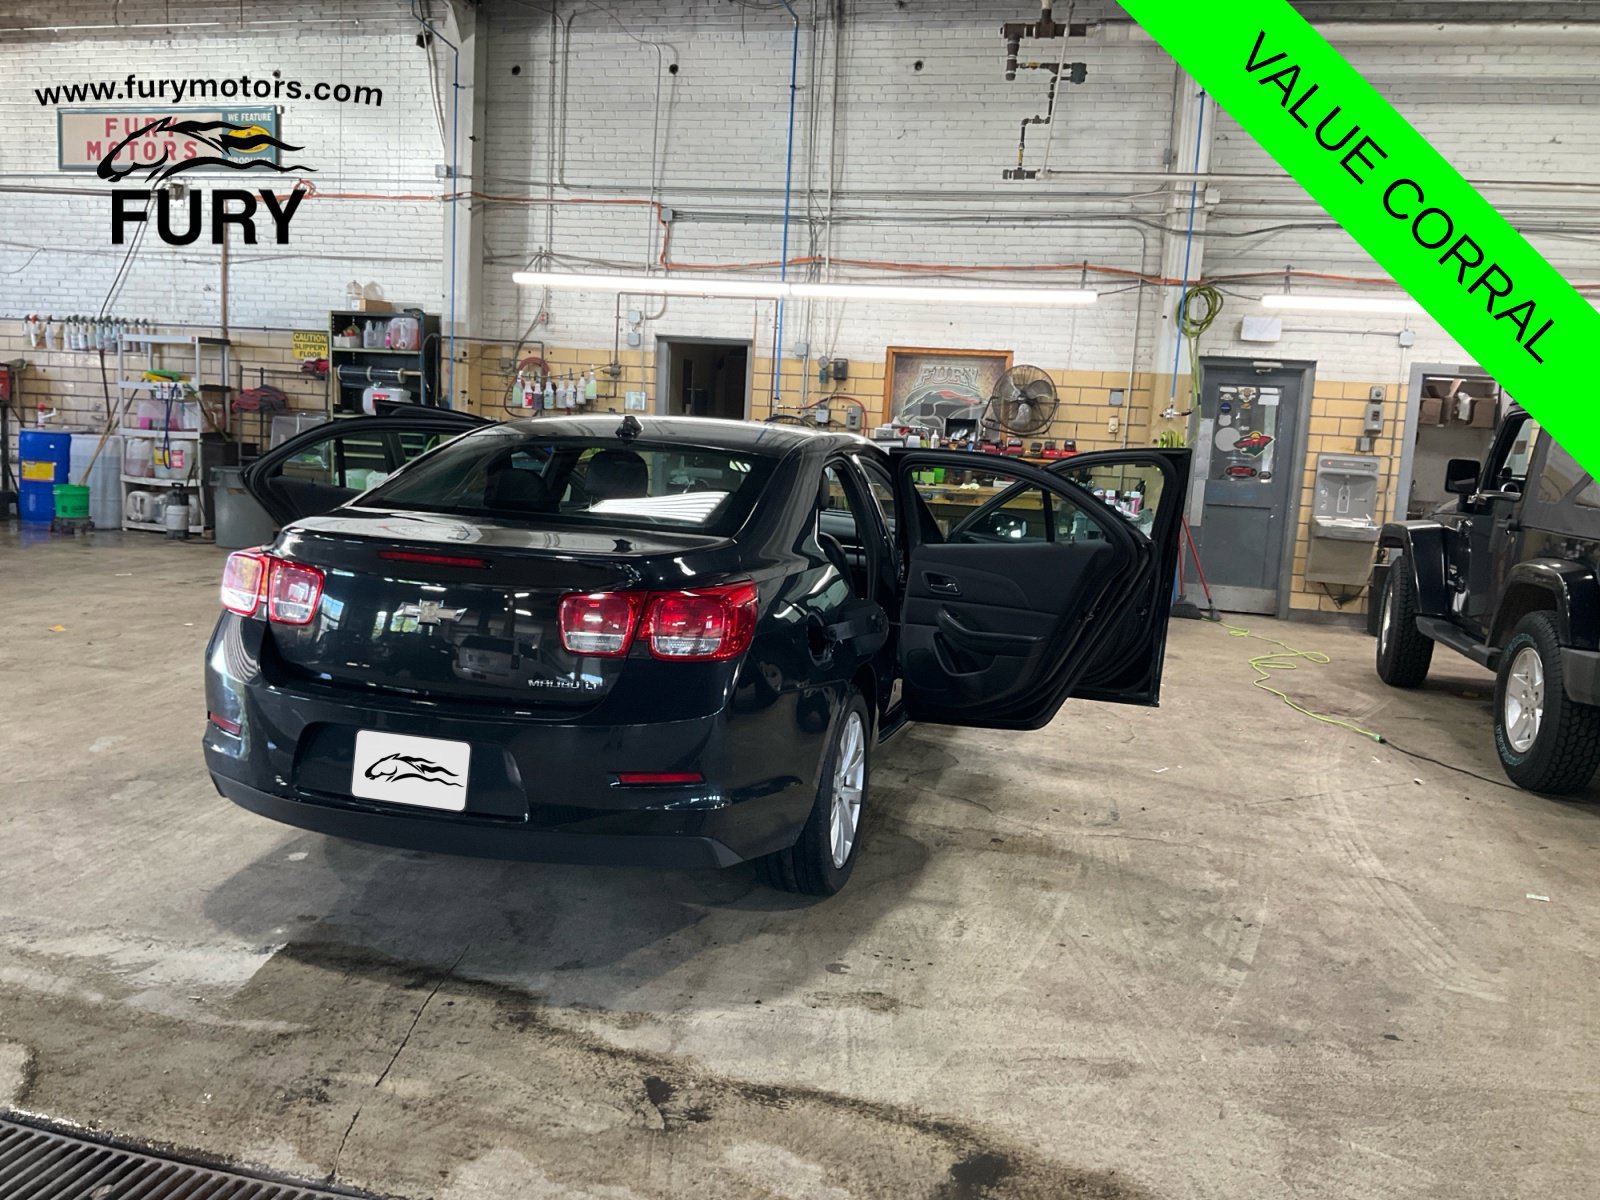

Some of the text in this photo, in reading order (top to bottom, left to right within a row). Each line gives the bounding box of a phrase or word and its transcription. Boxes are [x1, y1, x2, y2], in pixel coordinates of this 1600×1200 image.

[228, 113, 271, 121] WE FEATURE
[294, 333, 327, 342] CAUTION
[294, 343, 326, 352] SLIPPERY
[913, 365, 979, 388] FURY
